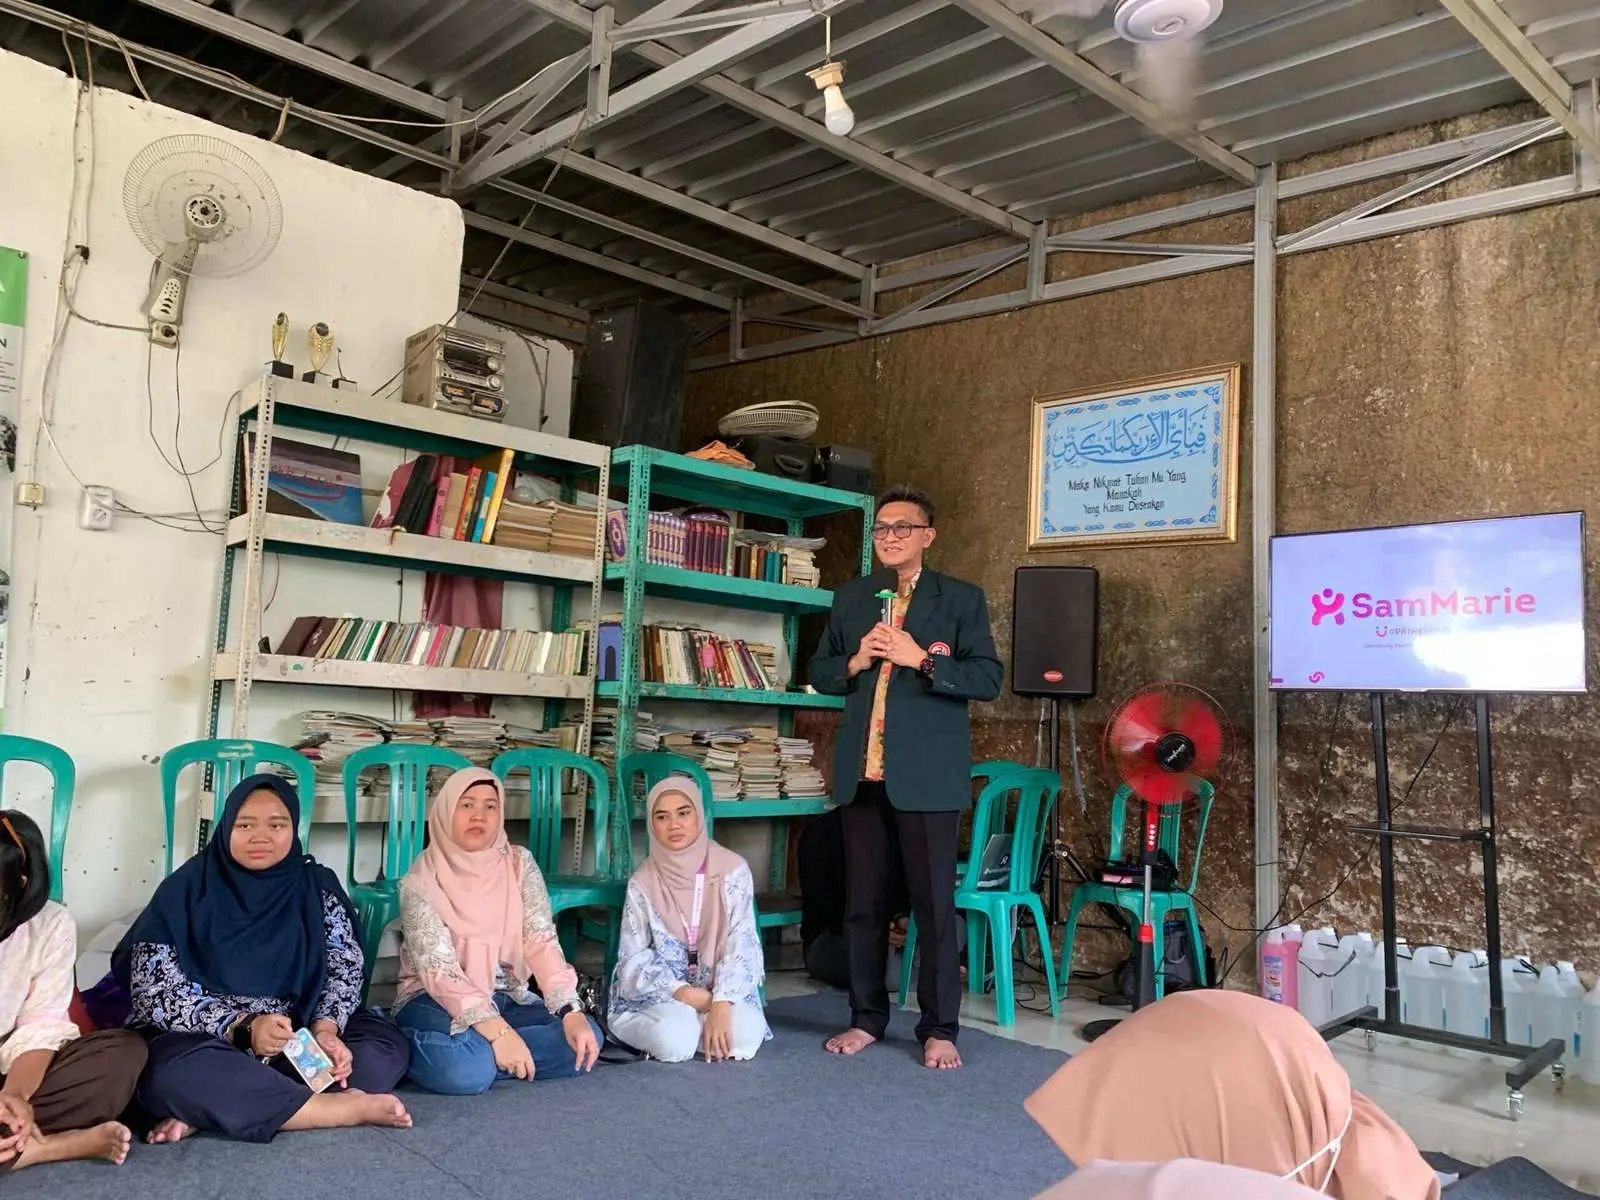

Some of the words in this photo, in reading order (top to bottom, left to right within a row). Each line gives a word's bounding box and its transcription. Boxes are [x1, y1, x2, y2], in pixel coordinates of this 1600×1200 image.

[1093, 475, 1121, 489] Nikmat
[1152, 471, 1164, 483] Mu
[1167, 469, 1186, 483] Yang
[1083, 504, 1101, 516] Yang
[1103, 502, 1124, 512] Kamu
[1352, 587, 1536, 618] SamMarie
